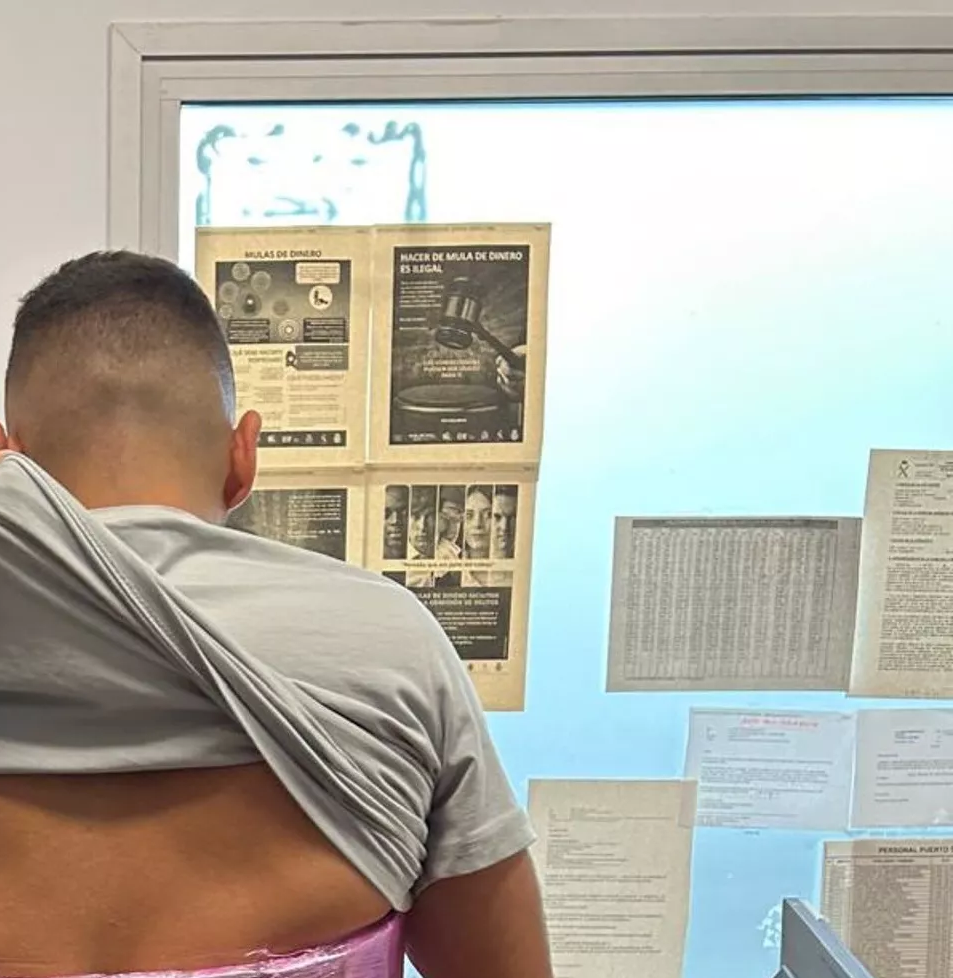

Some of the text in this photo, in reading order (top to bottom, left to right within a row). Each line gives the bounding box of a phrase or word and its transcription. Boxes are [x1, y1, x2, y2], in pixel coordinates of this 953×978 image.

[245, 249, 323, 259] MULAS DE DINERO
[400, 251, 523, 262] HACER DE MULA DE DINERO
[400, 263, 444, 274] ES ILEGAL
[878, 846, 918, 854] PERSONAL
[919, 845, 949, 853] PUERTO
